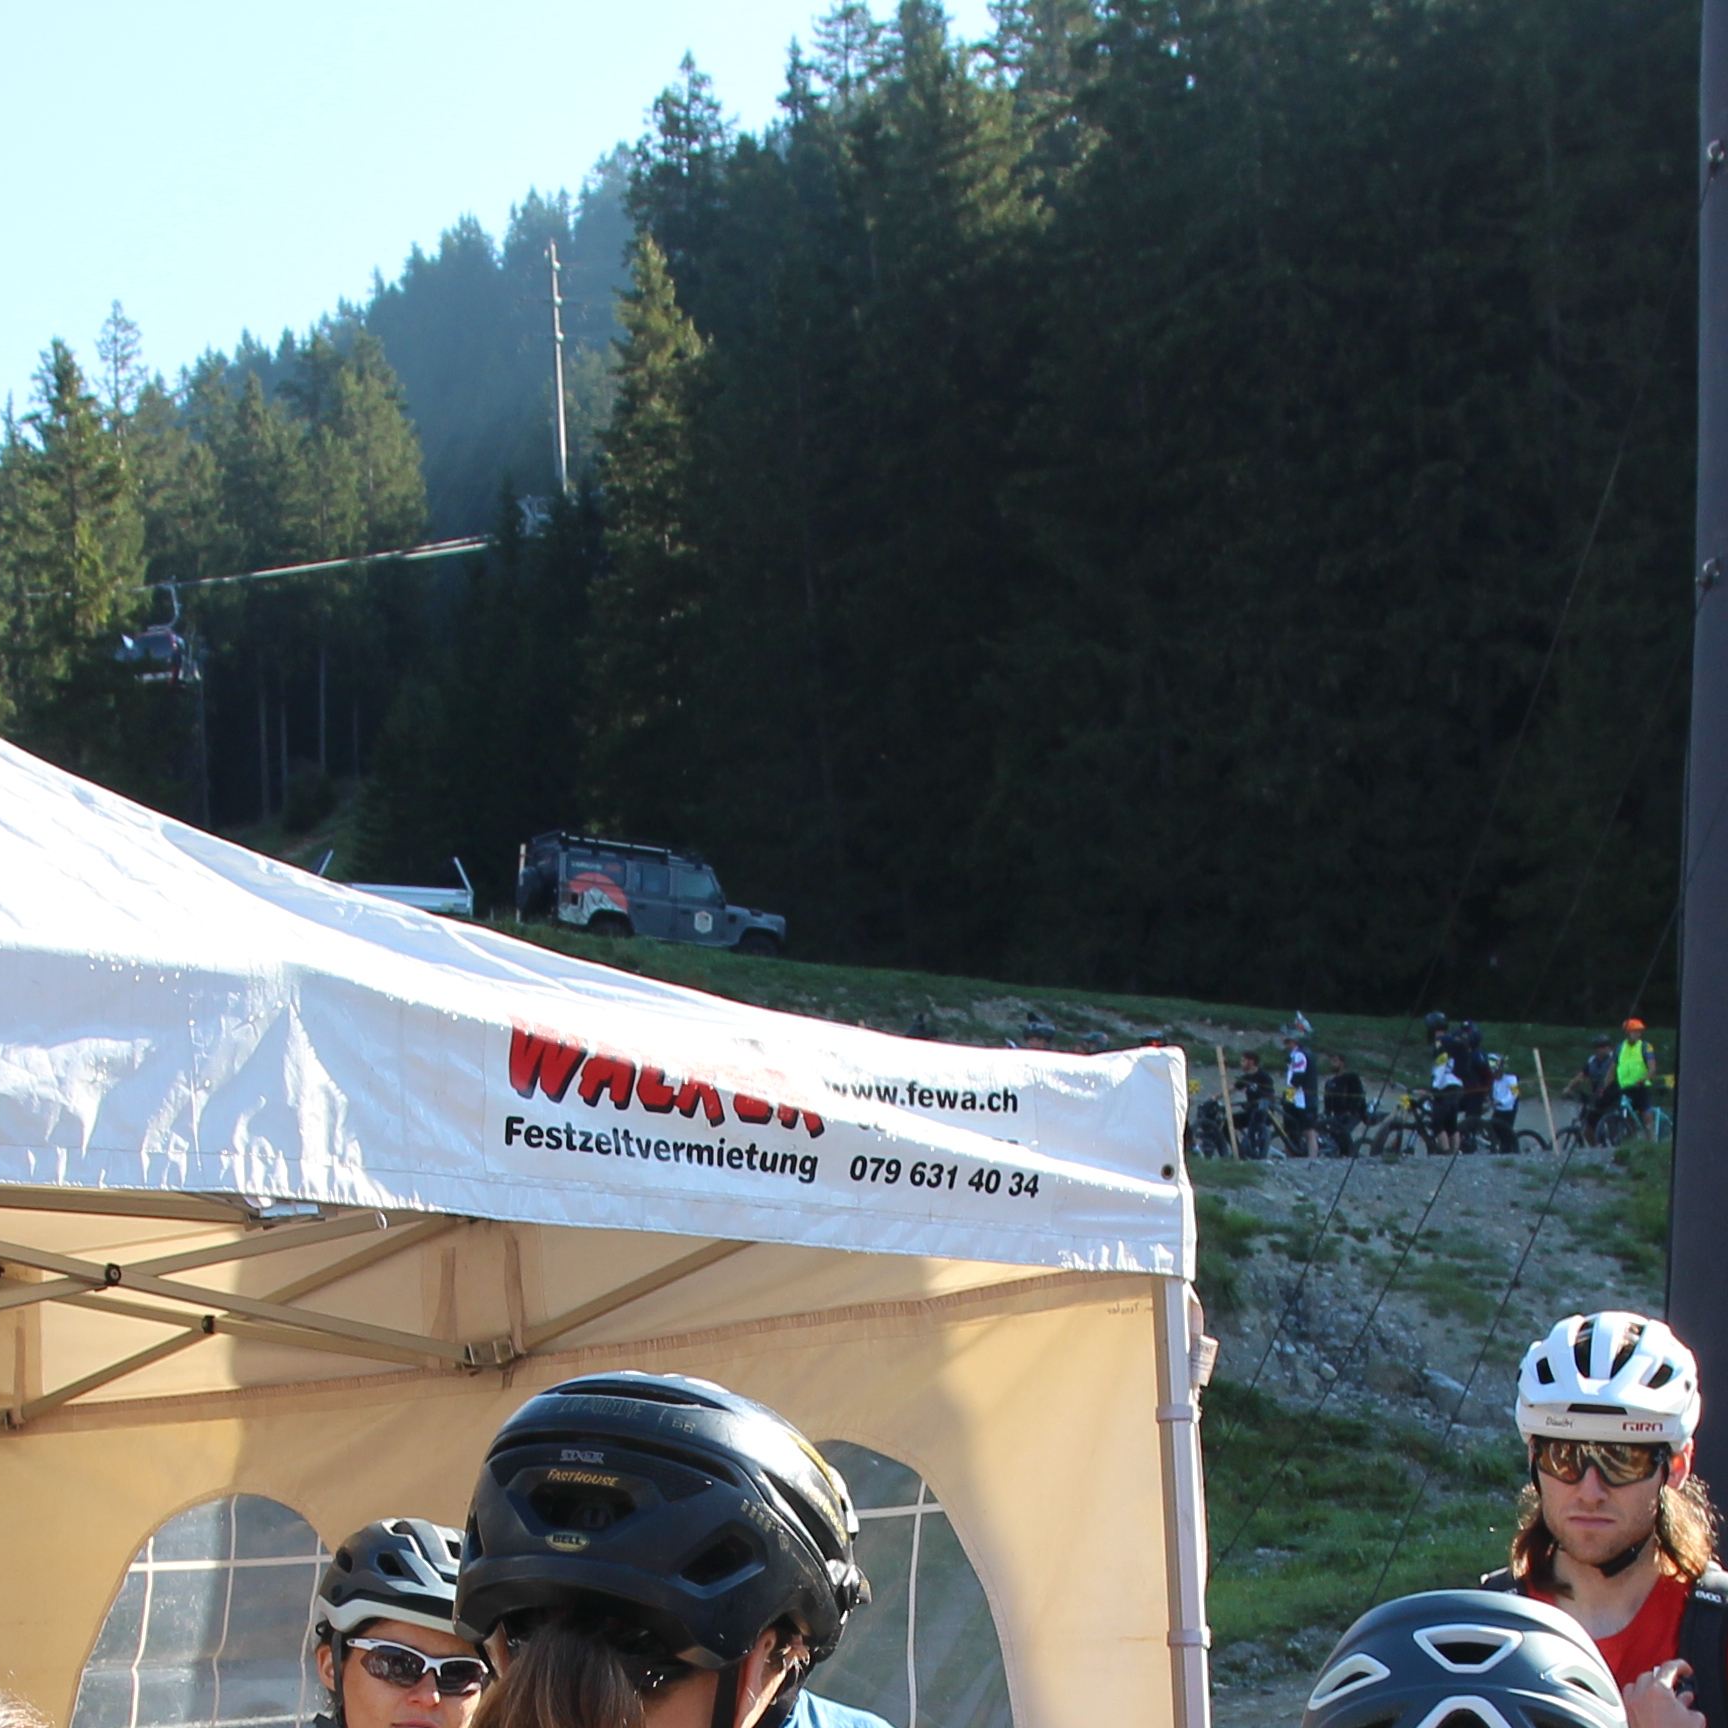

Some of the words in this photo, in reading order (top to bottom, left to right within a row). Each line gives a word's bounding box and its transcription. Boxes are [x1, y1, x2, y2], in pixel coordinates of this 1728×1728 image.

[505, 1115, 819, 1185] Festzeltvermietung
[849, 1155, 902, 1184] 079
[909, 1161, 959, 1190] 631
[968, 1167, 1001, 1195] 40
[1008, 1171, 1040, 1198] 34
[546, 1468, 620, 1487] FASTHOUSE
[552, 1533, 582, 1546] BELL
